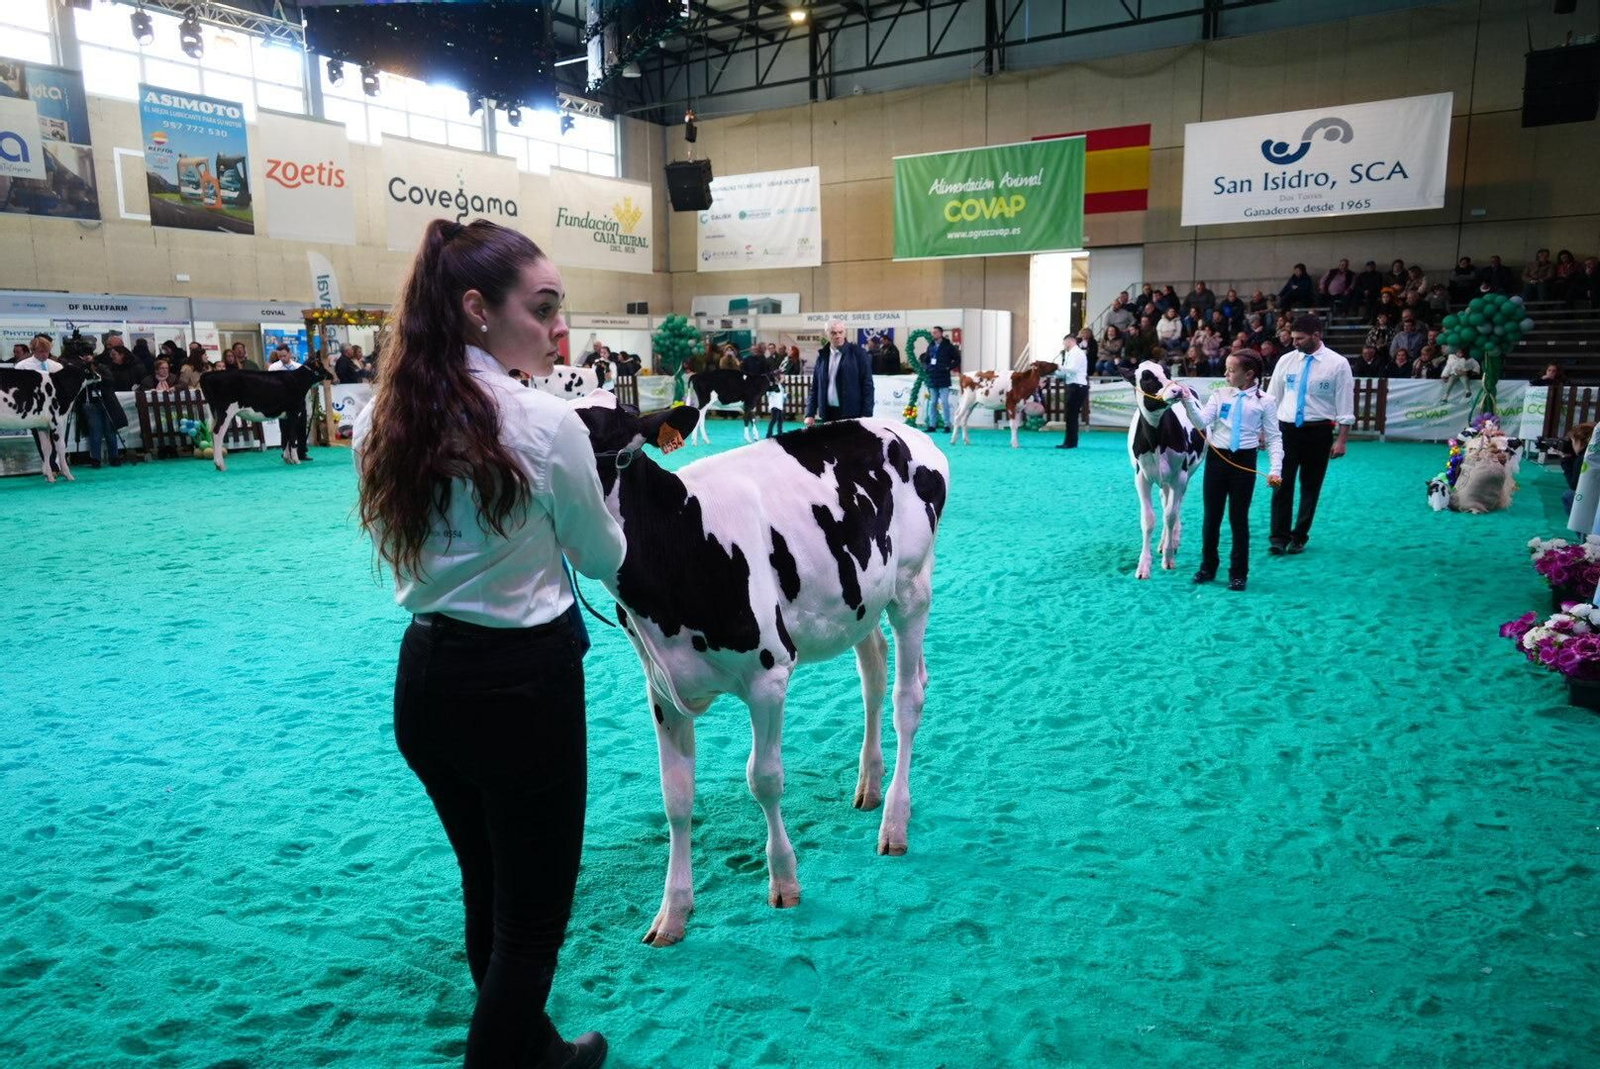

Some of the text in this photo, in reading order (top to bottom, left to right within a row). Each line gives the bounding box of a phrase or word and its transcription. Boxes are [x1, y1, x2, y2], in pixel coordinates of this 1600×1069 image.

[144, 91, 241, 119] ASIMOTO
[186, 124, 205, 134] 772
[208, 128, 228, 138] 530
[266, 159, 345, 189] zoetis
[928, 167, 1044, 196] Alimentación Animal
[1213, 160, 1409, 195] San Isidro, SCA
[388, 176, 518, 223] Covegama
[1279, 192, 1323, 202] Dos Torres
[944, 194, 1027, 222] COVAP
[1244, 199, 1371, 218] Ganaderos desde 1965
[556, 207, 619, 236] Fundación
[593, 231, 649, 248] CAJA RURAL
[947, 227, 1021, 239] www.agrocovap.es
[82, 304, 128, 312] BLUEFARM
[807, 314, 830, 322] WORLD
[1319, 381, 1330, 390] 18
[1405, 409, 1449, 420] COVAP
